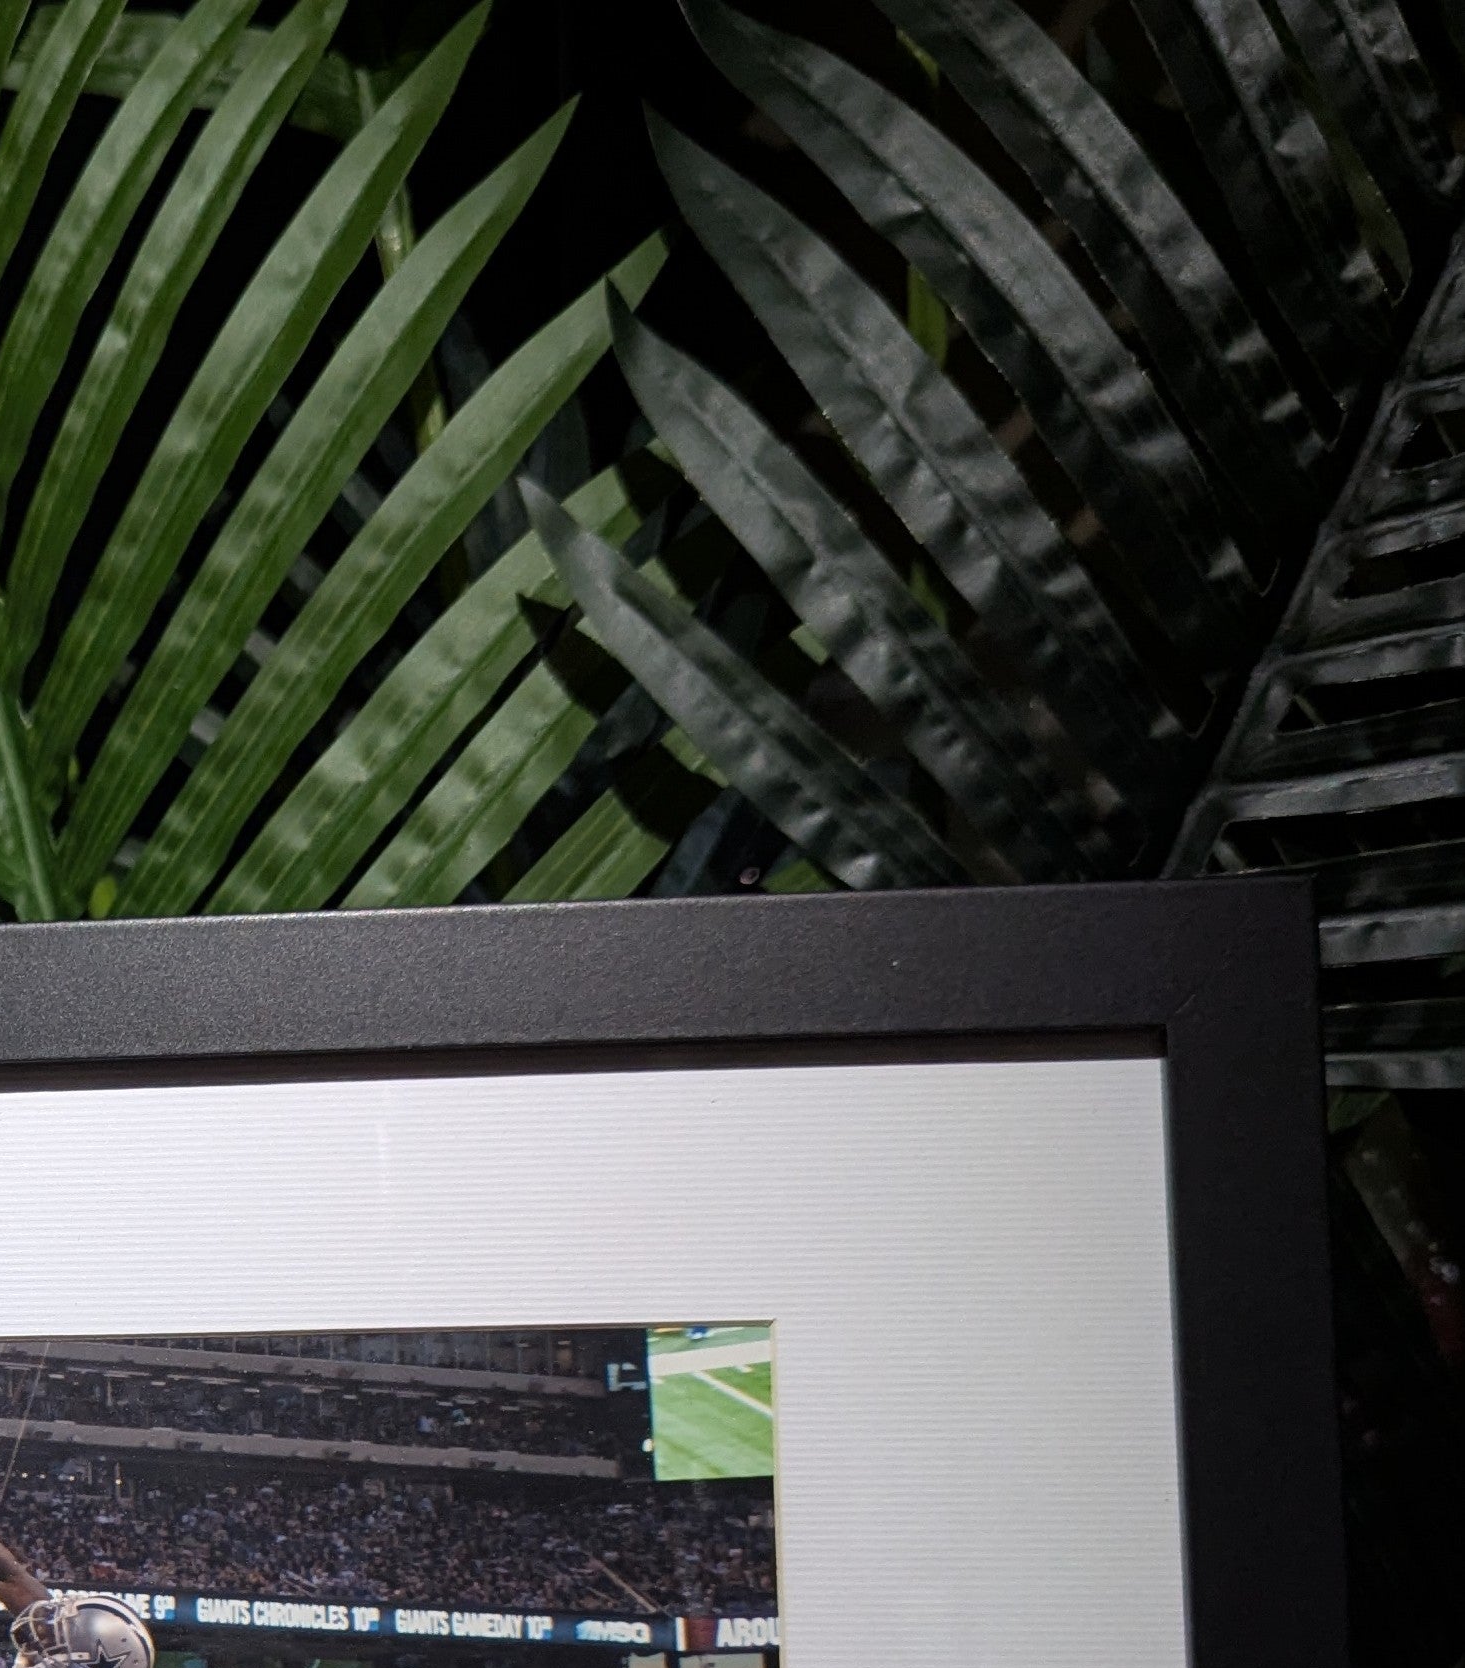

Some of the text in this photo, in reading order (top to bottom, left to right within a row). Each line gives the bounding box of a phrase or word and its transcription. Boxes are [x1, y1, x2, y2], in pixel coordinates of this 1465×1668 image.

[196, 1597, 250, 1626] GIANTS
[253, 1600, 349, 1631] CHRONICLES
[394, 1609, 449, 1636] GIANTS
[452, 1611, 523, 1640] GAMEDAY
